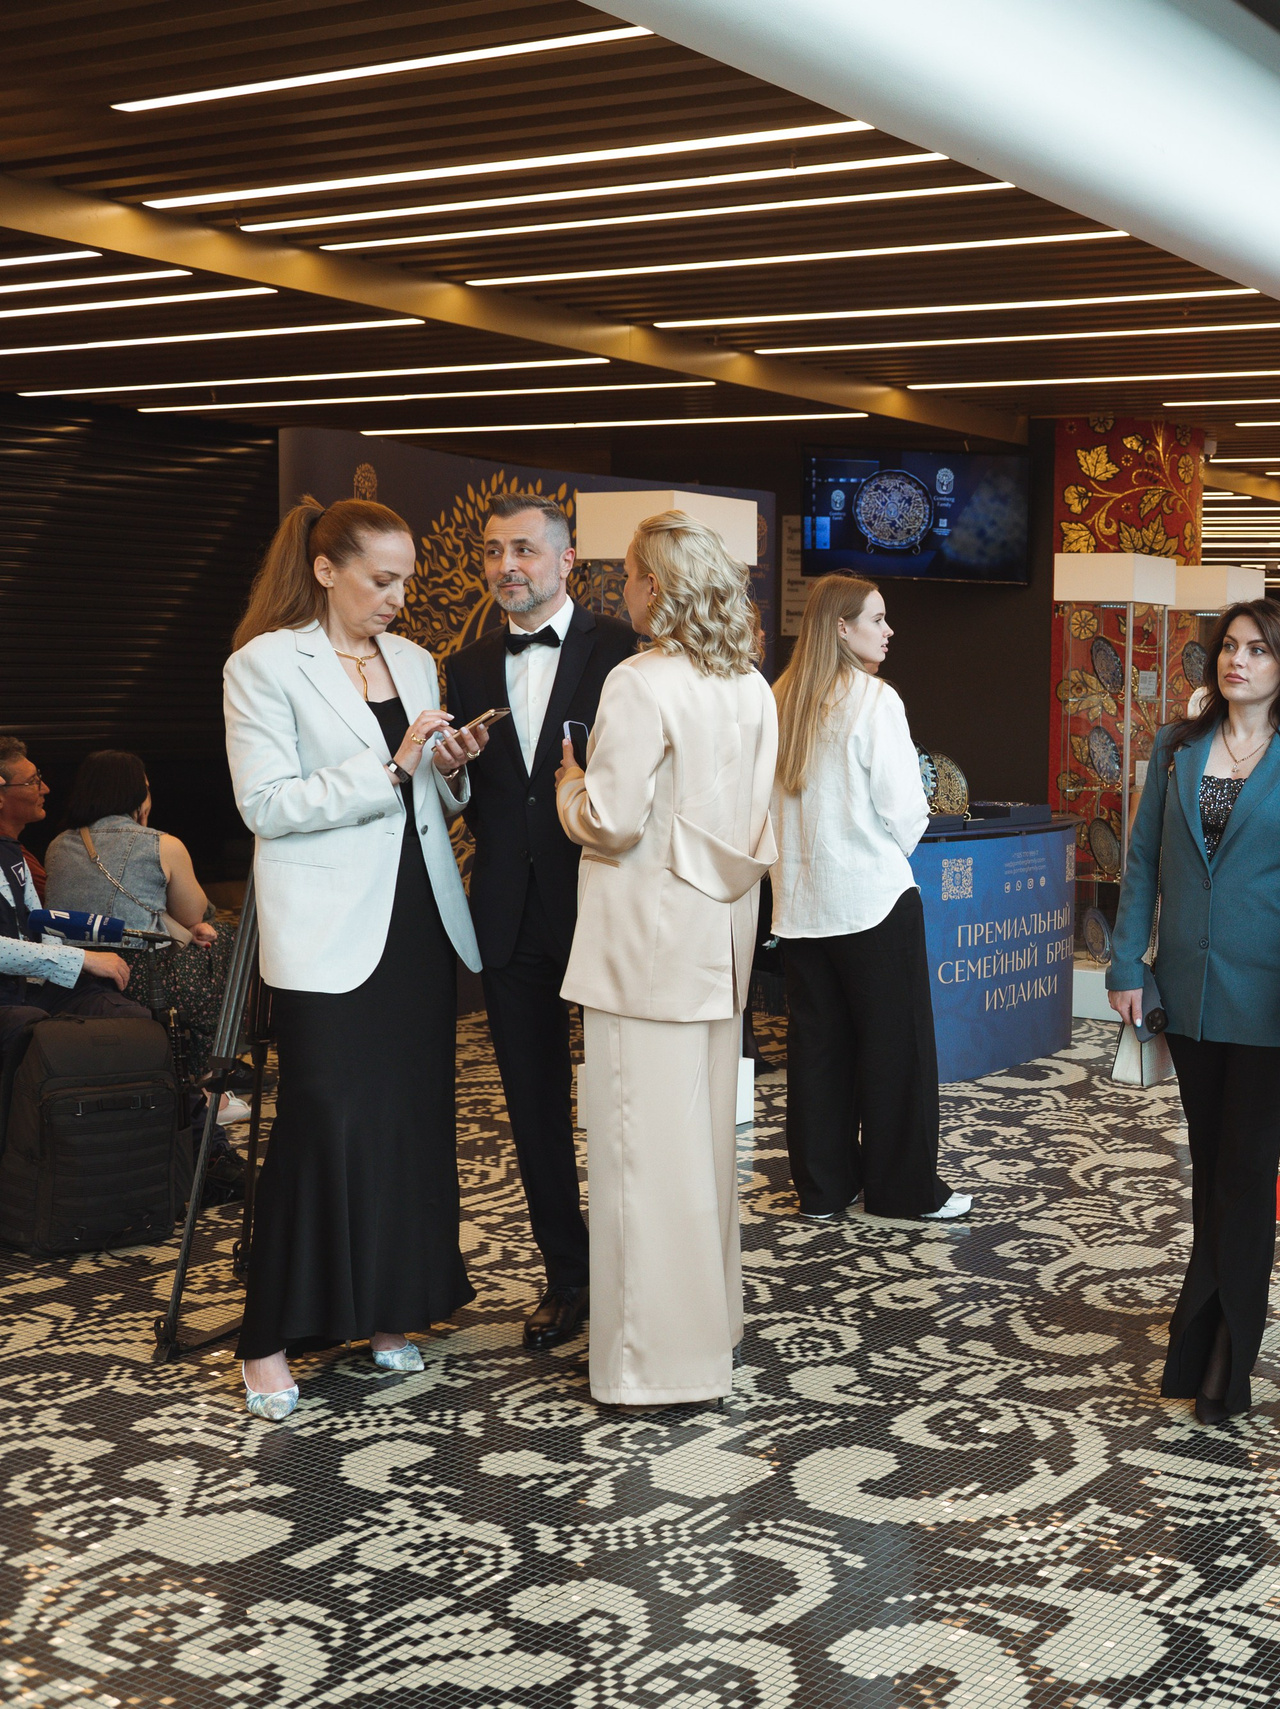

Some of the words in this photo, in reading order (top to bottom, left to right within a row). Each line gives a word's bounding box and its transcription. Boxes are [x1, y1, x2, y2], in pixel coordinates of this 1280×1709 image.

[957, 901, 1071, 948] ПРЕМИАЛЬНЫЙ
[937, 941, 1038, 985] СЕМЕЙНЫЙ
[985, 974, 1058, 1012] ИУДАИКИ
